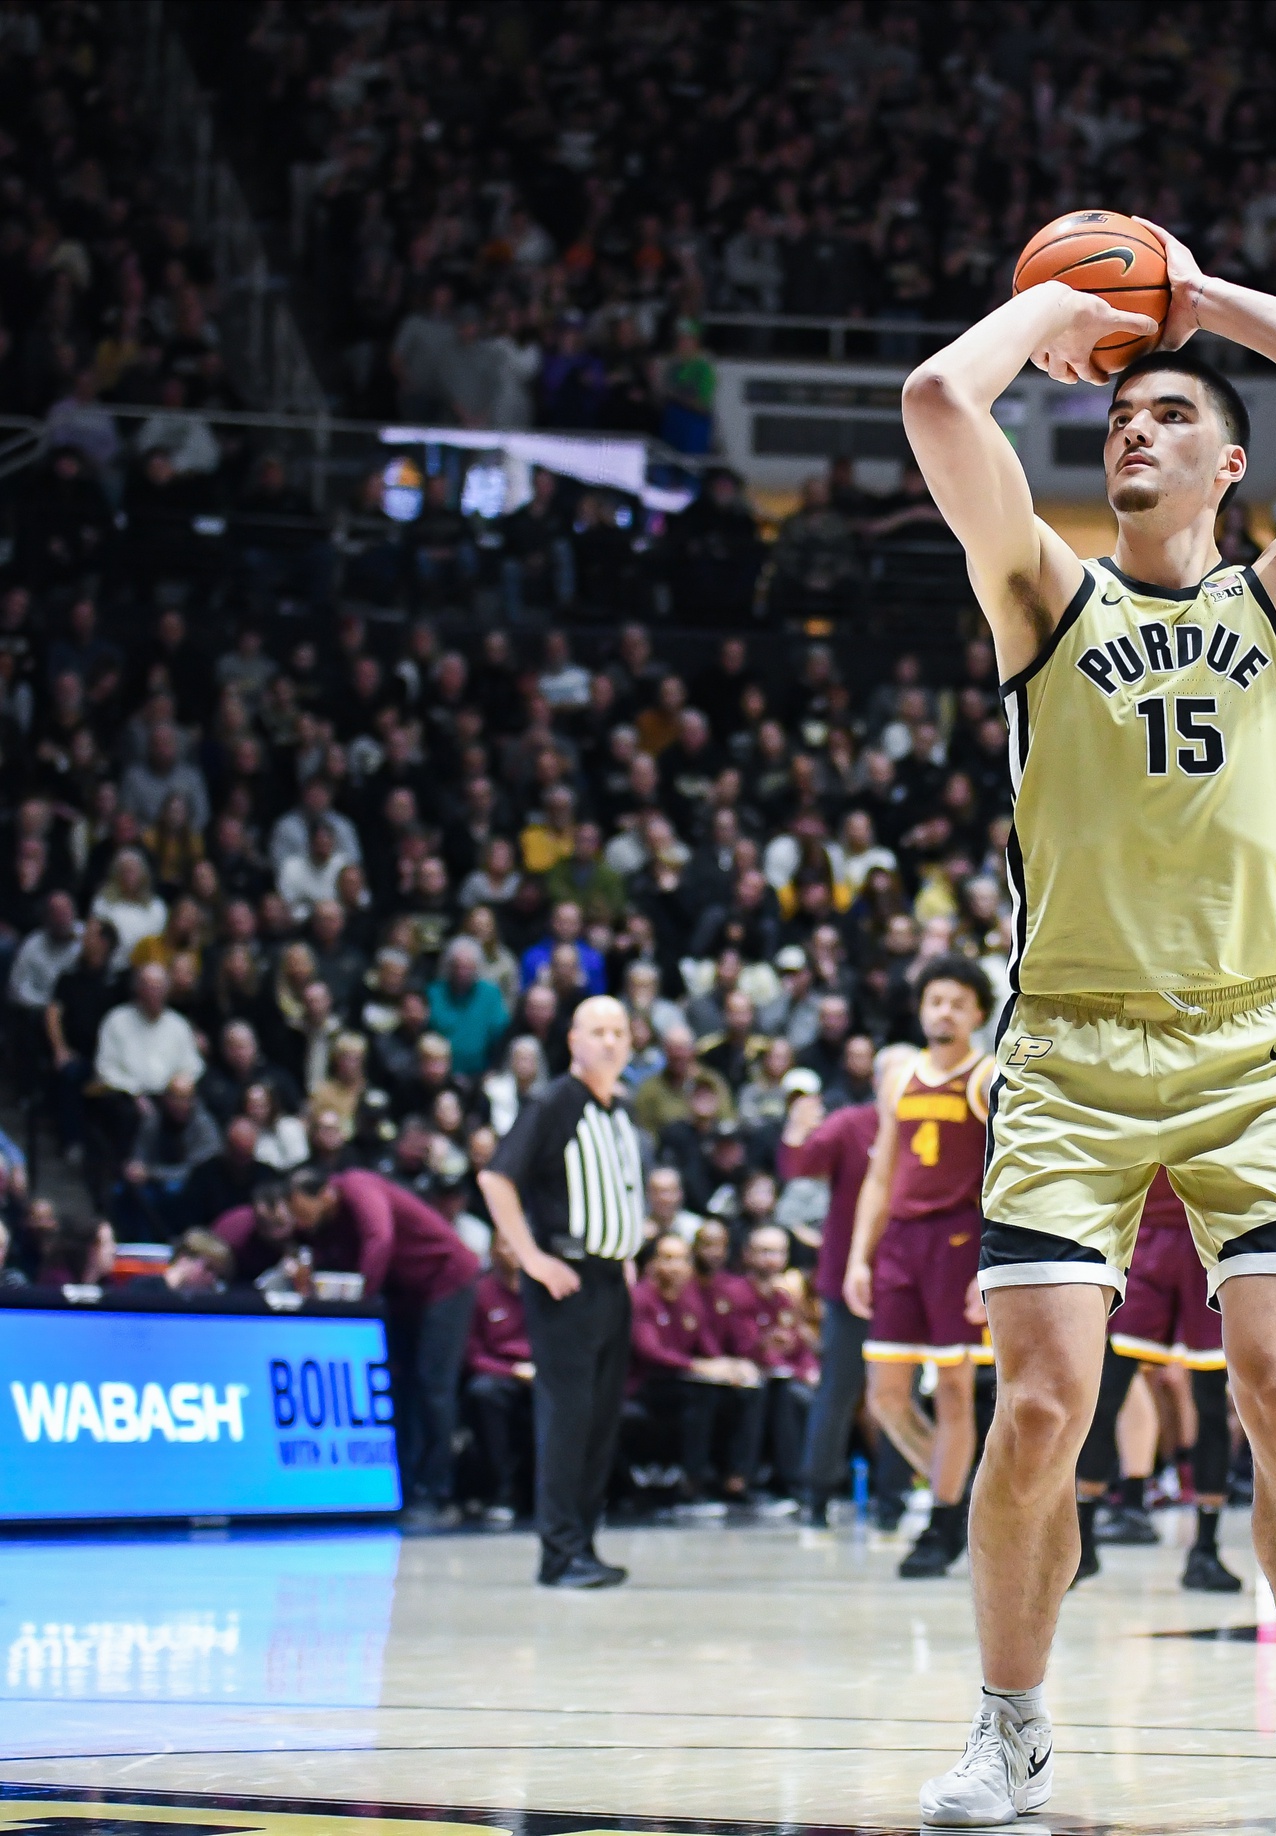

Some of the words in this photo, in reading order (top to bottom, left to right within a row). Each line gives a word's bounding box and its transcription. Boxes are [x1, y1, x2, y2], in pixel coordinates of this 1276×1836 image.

[1074, 620, 1273, 698] PURDUE
[1135, 695, 1227, 777] 15
[910, 1119, 940, 1167] 4
[9, 1380, 245, 1443] WABASH
